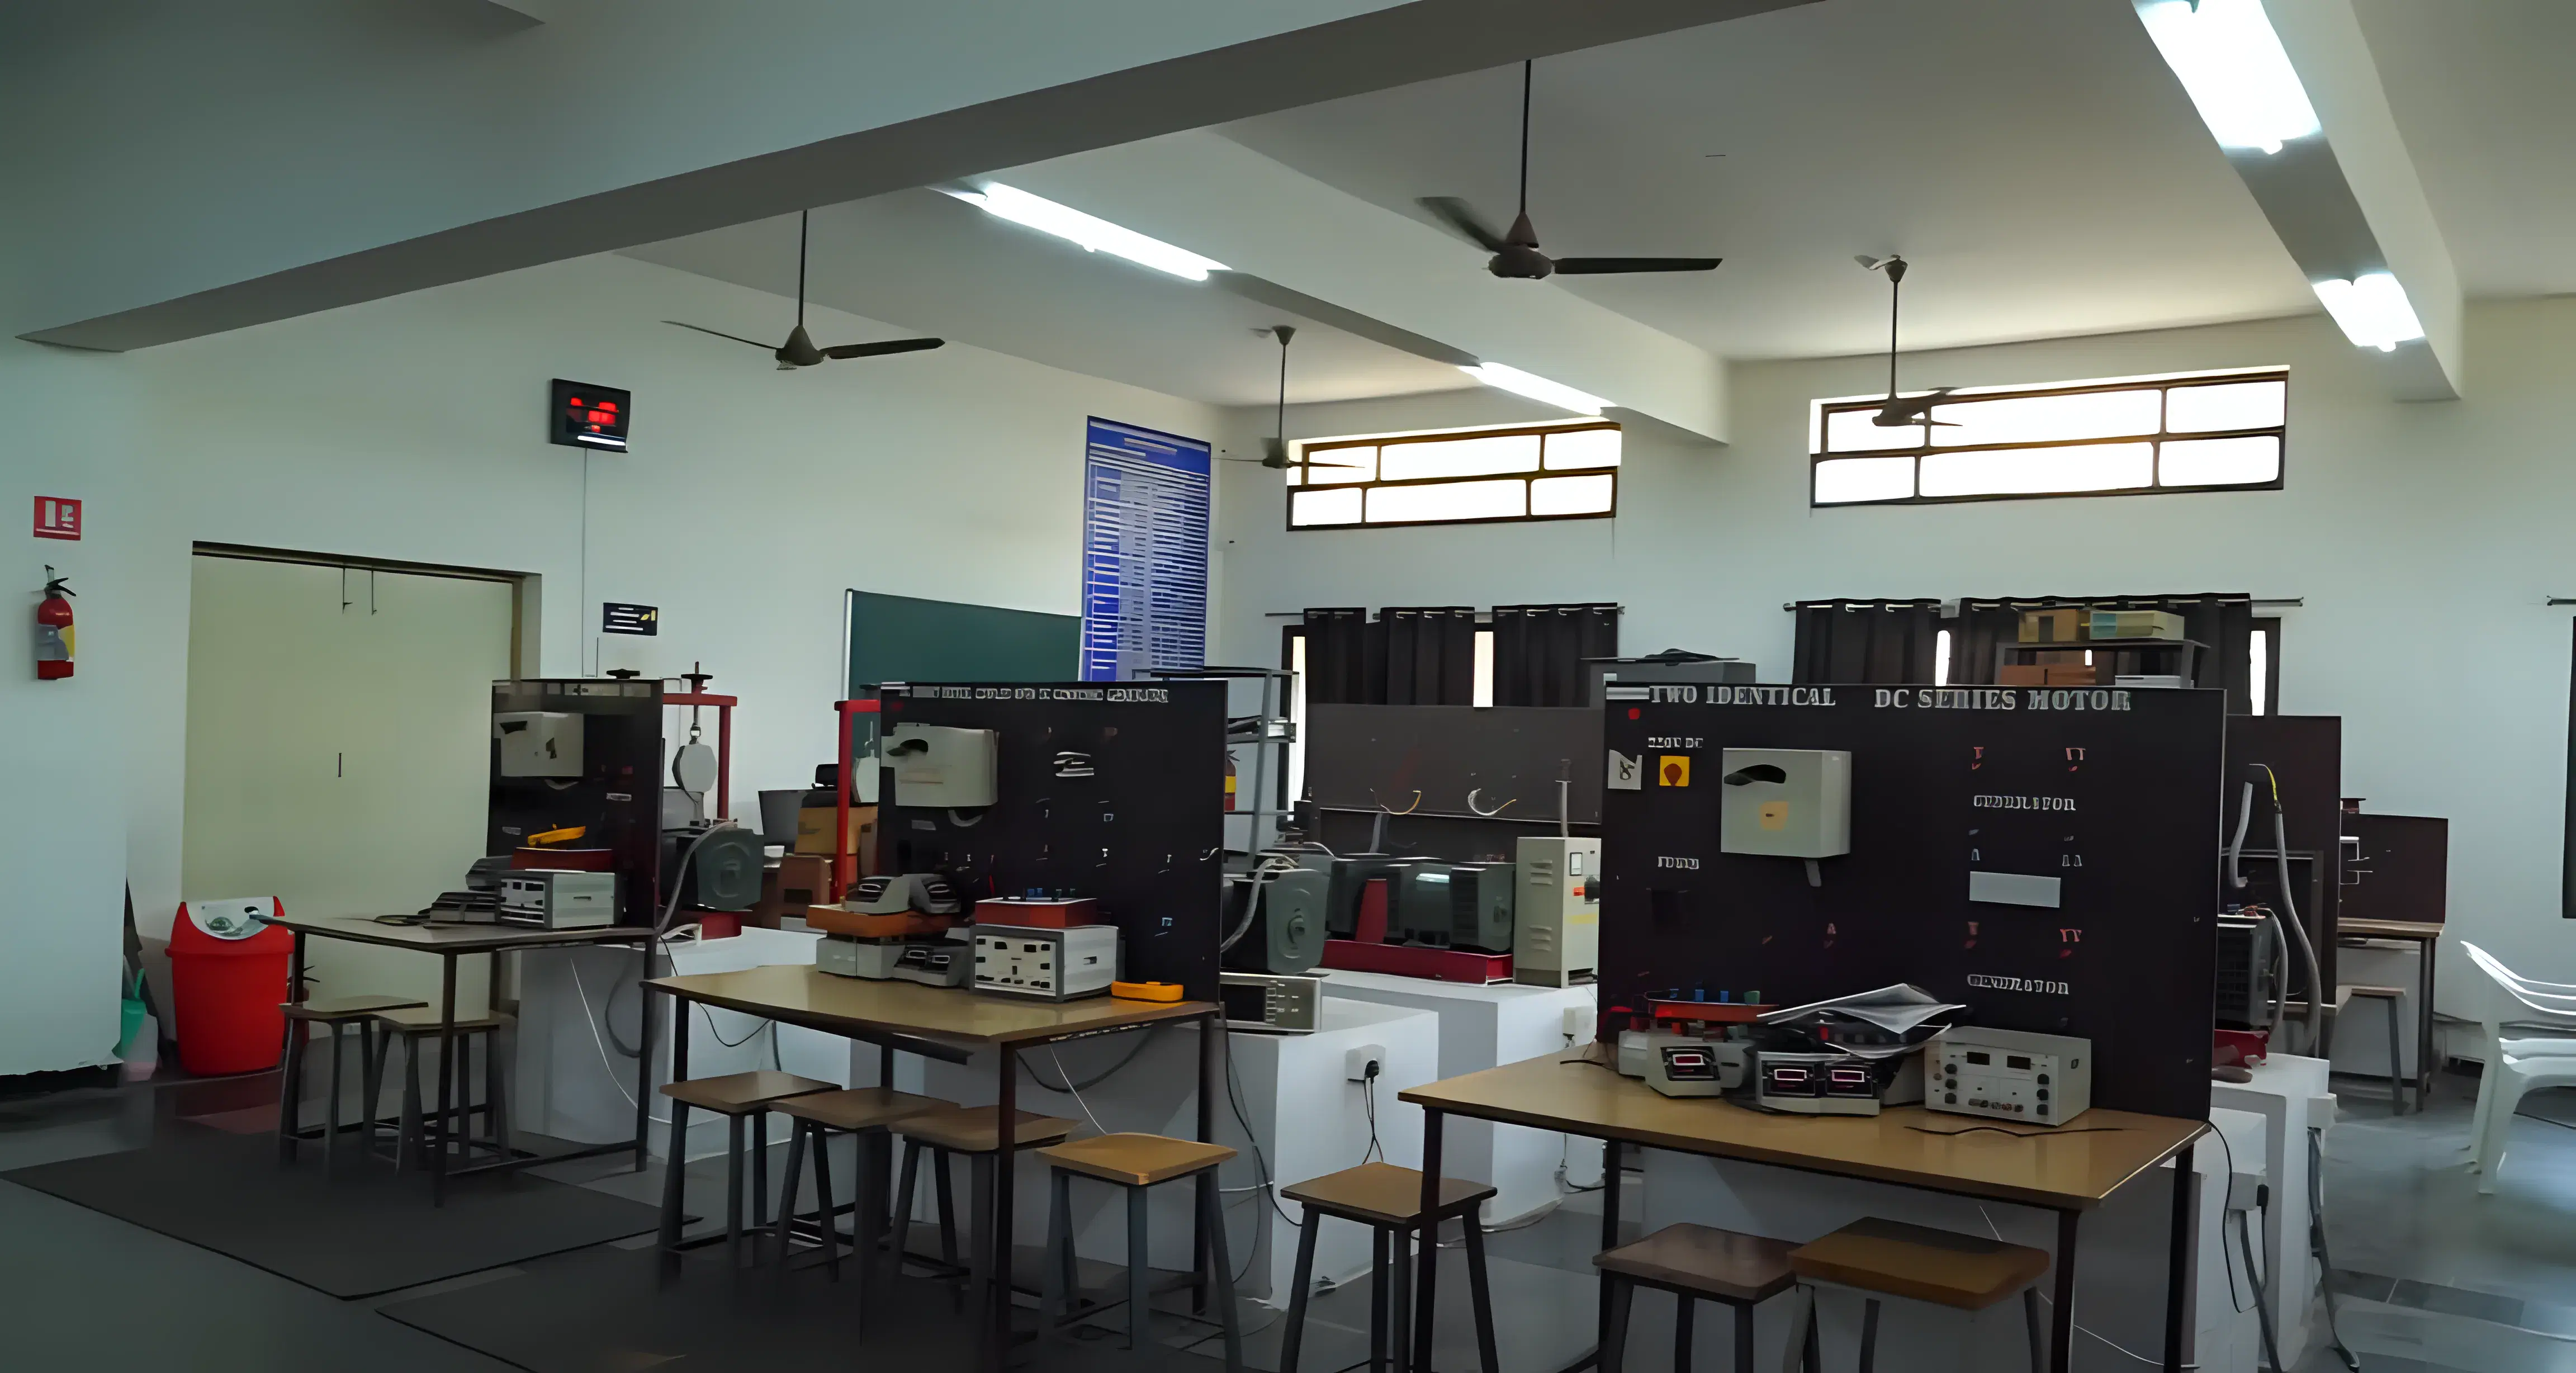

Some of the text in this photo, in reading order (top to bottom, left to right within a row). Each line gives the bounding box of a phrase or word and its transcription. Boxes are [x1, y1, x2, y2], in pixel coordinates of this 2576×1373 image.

[1650, 686, 1697, 703] TWO
[1706, 686, 1836, 706] IDENTICAL
[1874, 689, 1909, 708] DC
